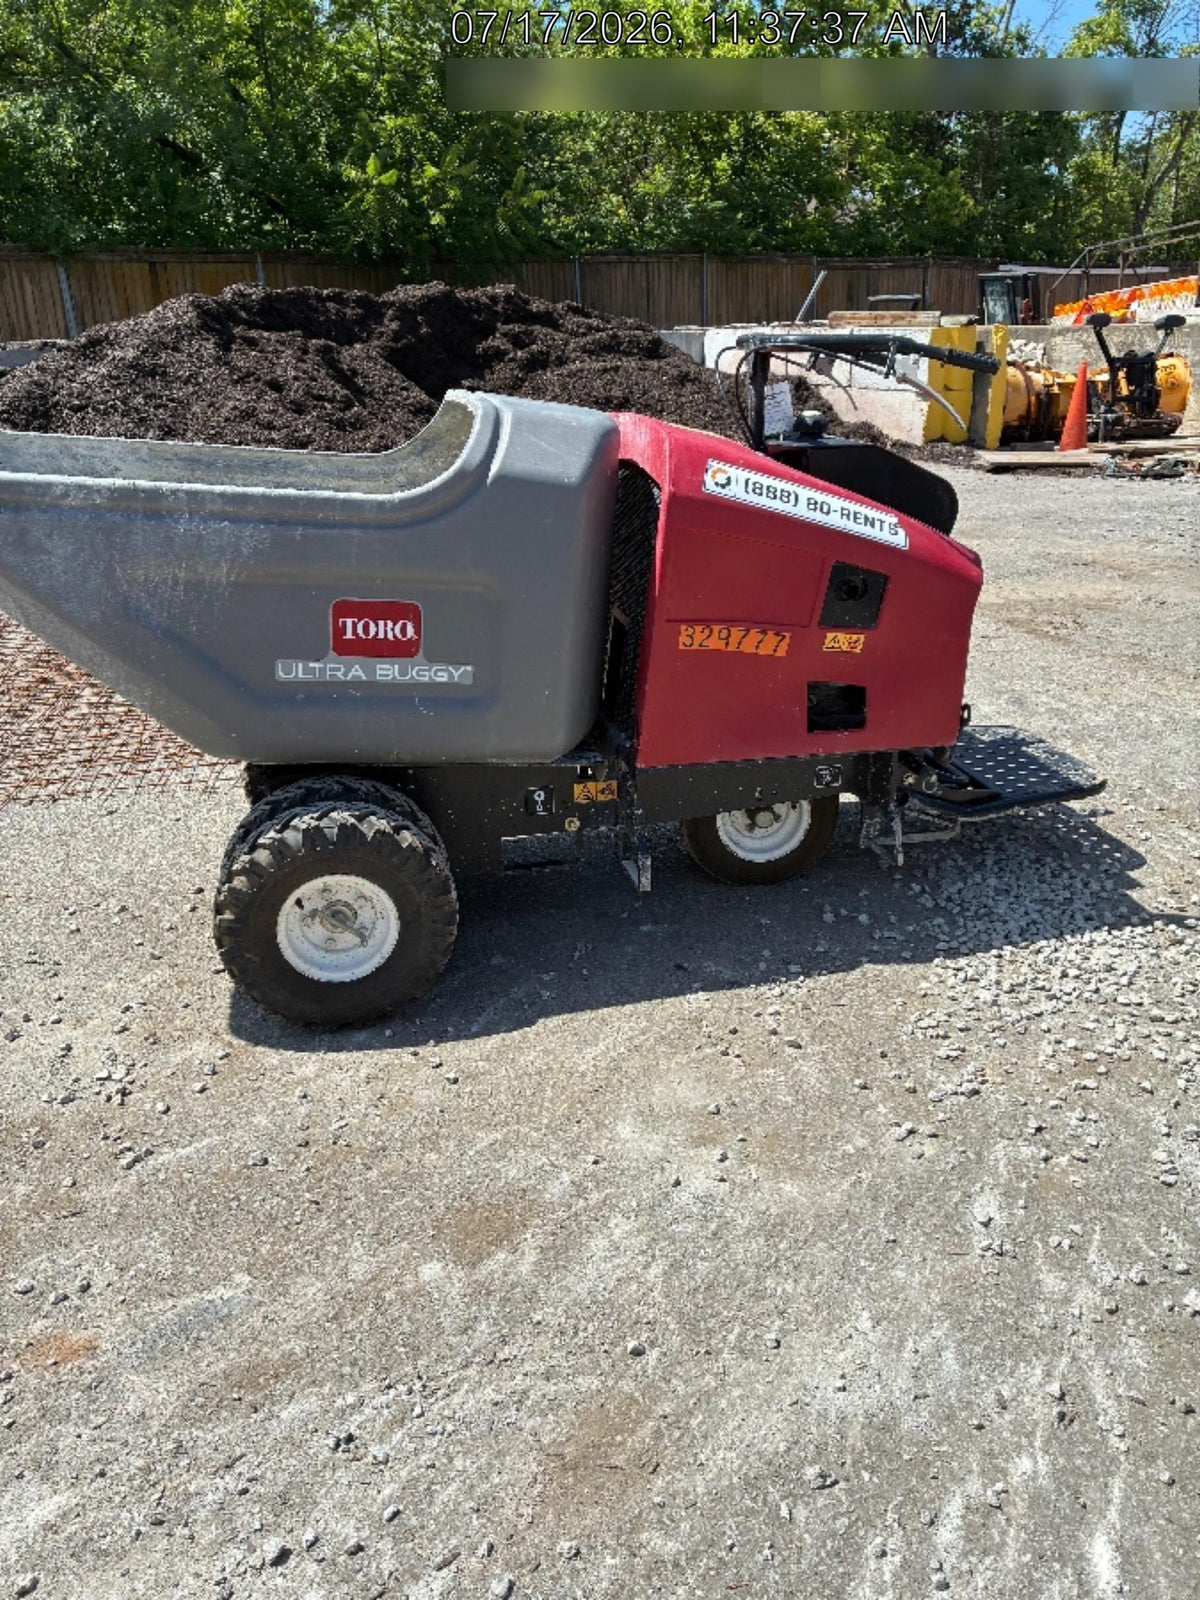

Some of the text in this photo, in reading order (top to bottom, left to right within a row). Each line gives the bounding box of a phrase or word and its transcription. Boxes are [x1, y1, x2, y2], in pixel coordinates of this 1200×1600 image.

[744, 477, 799, 507] (888)
[339, 618, 415, 641] TORO
[682, 625, 786, 654] 329777
[278, 662, 367, 681] ULTRA
